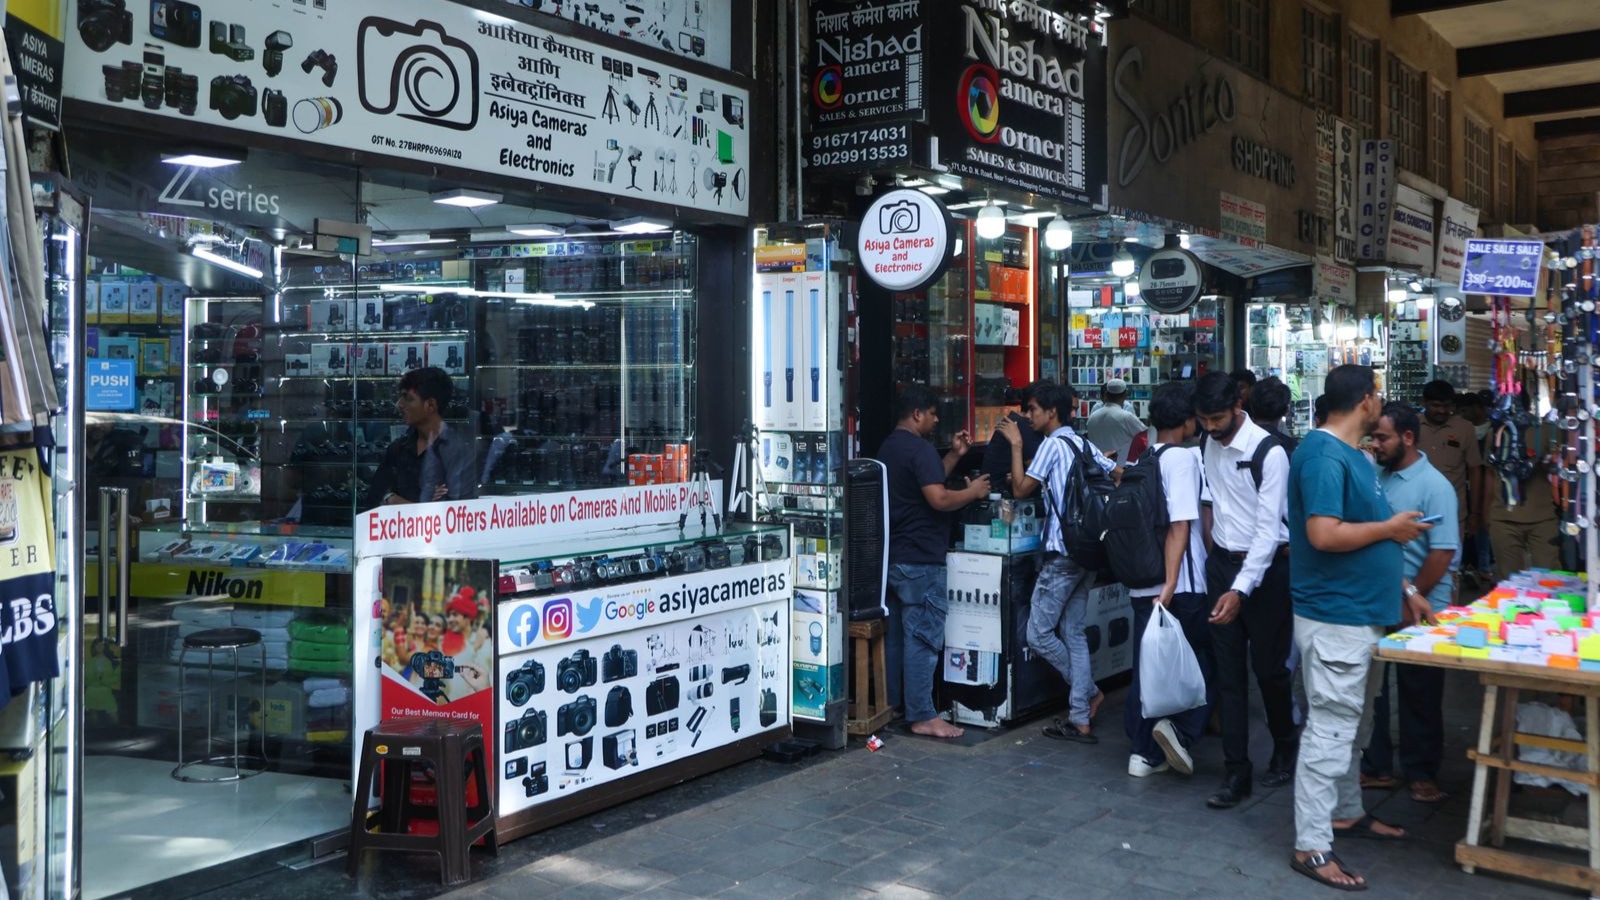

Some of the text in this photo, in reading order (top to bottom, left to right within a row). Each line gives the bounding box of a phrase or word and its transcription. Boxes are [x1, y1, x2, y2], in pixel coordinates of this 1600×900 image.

[22, 32, 48, 58] ASIYA
[815, 23, 923, 67] Nishad
[961, 4, 1085, 99] Nishad
[518, 56, 561, 79] आणि
[489, 101, 587, 137] Asiya Cameras
[819, 104, 904, 121] SALES & SERVICES
[526, 134, 552, 151] and
[812, 125, 907, 149] 9167174031
[499, 148, 575, 177] Electronics
[812, 144, 908, 167] 9029913533
[967, 148, 1069, 186] SALES & SERVICES
[1234, 136, 1296, 187] SHOPPING
[208, 184, 280, 216] series
[864, 236, 934, 254] Asiya Cameras
[1469, 243, 1491, 254] SALE
[1492, 244, 1516, 255] SALE
[1516, 245, 1540, 256] SALE
[875, 262, 923, 273] Electronics
[892, 252, 908, 262] and
[90, 375, 129, 386] PUSH
[796, 442, 807, 450] 12
[369, 507, 441, 547] Exchange
[445, 505, 487, 535] Offers
[490, 499, 547, 530] Available
[550, 504, 565, 524] on
[568, 494, 618, 521] Cameras
[620, 491, 642, 517] And
[643, 487, 677, 514] Mobile
[186, 570, 263, 599] Nikon
[659, 569, 786, 614] asiyacameras
[605, 598, 655, 620] Google
[391, 707, 403, 715] Our
[405, 708, 420, 716] Best
[422, 709, 450, 719] Memory
[452, 711, 468, 719] Card
[470, 712, 480, 720] for
